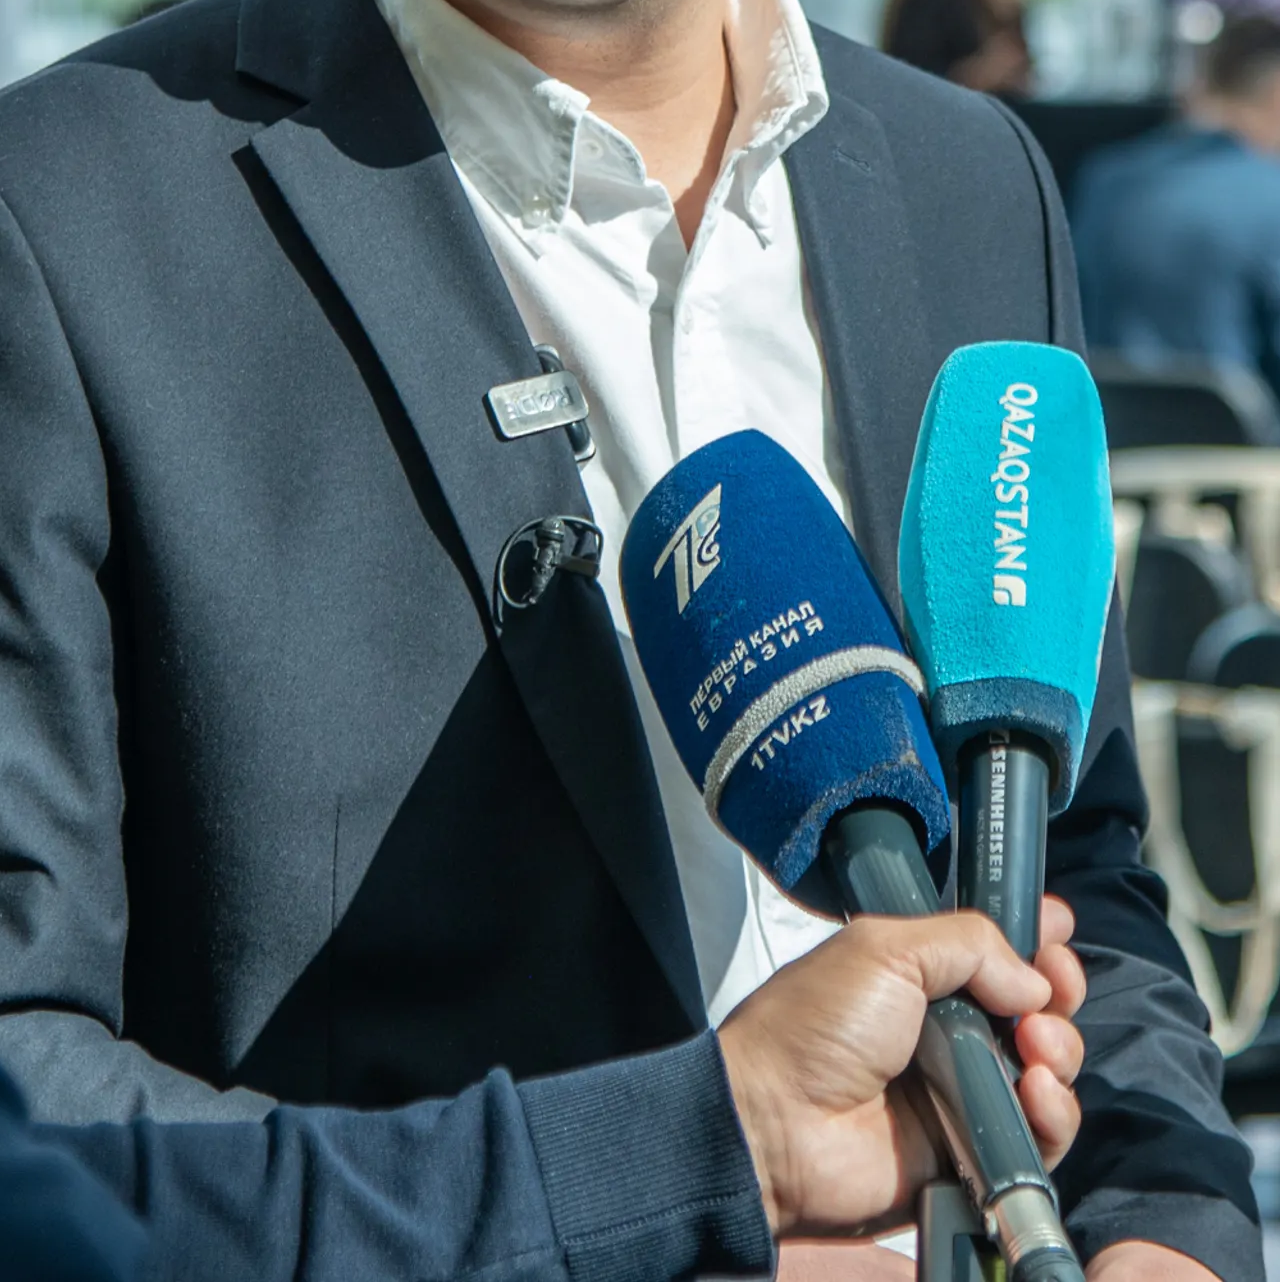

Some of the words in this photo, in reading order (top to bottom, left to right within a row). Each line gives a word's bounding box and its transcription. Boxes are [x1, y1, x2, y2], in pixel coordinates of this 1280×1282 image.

[989, 382, 1039, 572] QAZAQSTAN
[689, 639, 749, 716] ПЕРВЫЙ
[749, 600, 817, 651] КАНАЛ
[750, 695, 832, 771] 1TV.KZ
[988, 749, 1007, 883] SENNHEISER
